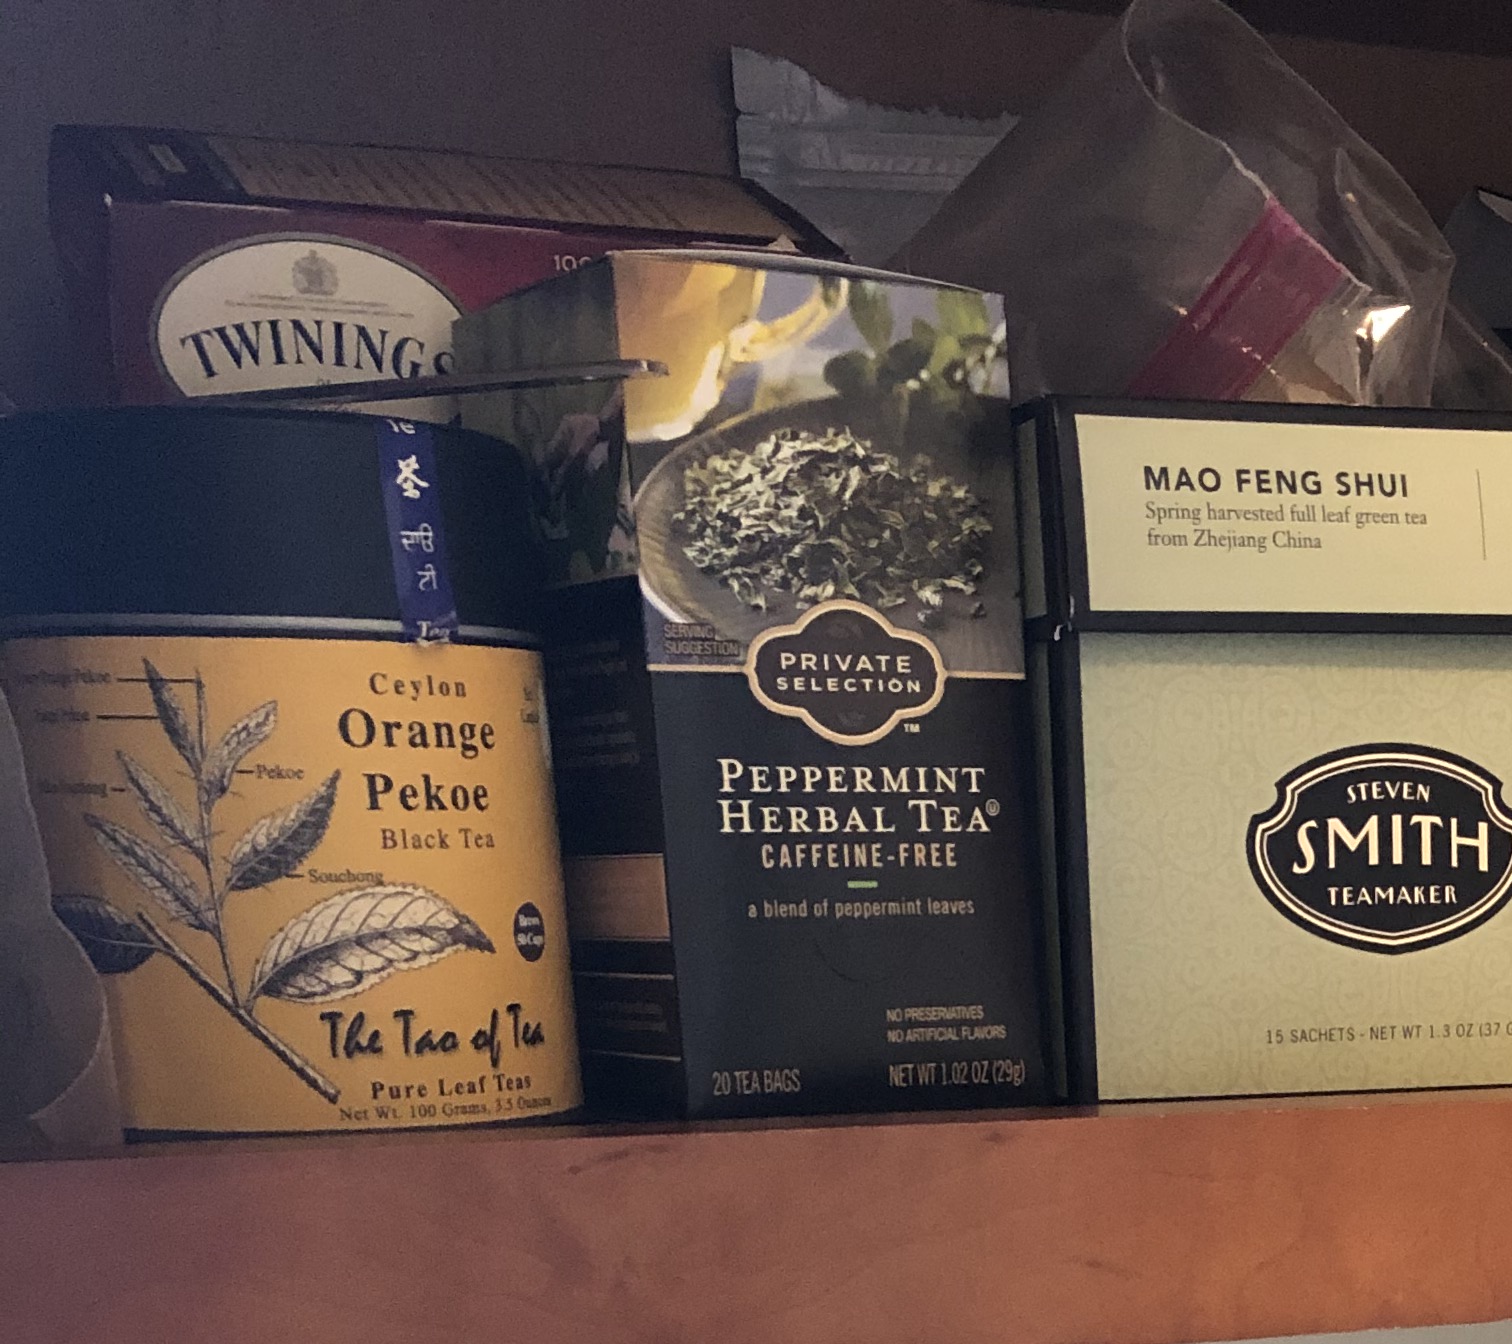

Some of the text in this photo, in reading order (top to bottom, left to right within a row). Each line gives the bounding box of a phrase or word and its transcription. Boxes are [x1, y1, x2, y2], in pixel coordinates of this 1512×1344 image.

[1143, 465, 1408, 499] MAO FENG SHUI
[1144, 501, 1428, 532] Spring harvested full leaf green tea
[1146, 527, 1322, 554] from Zhejiang China
[663, 623, 716, 640] SERVING
[663, 640, 740, 657] SUGGESTION
[780, 651, 913, 674] PRIVATE
[368, 673, 468, 701] Ceylon
[776, 675, 922, 695] SELECTION
[338, 708, 496, 760] Orange
[255, 764, 304, 780] Pekoe
[717, 757, 987, 794] PEPPERMINT
[361, 772, 490, 813] Pekoe
[1346, 781, 1431, 805] STEVEN
[717, 798, 991, 835] HERBAL TEA
[380, 828, 496, 851] Black Tea
[1292, 813, 1490, 875] SMITH
[761, 842, 959, 870] CAFFEINE-FREE
[308, 867, 384, 888] Souchong
[748, 896, 976, 921] a blend of peppermint leaves
[1327, 884, 1459, 907] TEAMAKER
[886, 1004, 985, 1024] NO PRESERVATIVES
[319, 1010, 384, 1059] The
[392, 1010, 459, 1058] Tao
[470, 1008, 501, 1068] of
[506, 1003, 545, 1048] Tea
[886, 1024, 1008, 1044] NO ARTIFICIAL FLAVORS
[1265, 1028, 1285, 1045] 15
[1290, 1026, 1356, 1045] SACHETS
[1369, 1026, 1398, 1042] NET
[1400, 1025, 1422, 1041] WT
[1428, 1023, 1451, 1040] 1.3
[1454, 1023, 1475, 1039] OZ
[1478, 1021, 1501, 1041] (37
[712, 1069, 801, 1097] 20 TEA BAGS
[888, 1057, 1026, 1088] NET WT 1.02 OZ (29g)
[370, 1073, 532, 1100] Pure Leaf Teas
[339, 1107, 369, 1122] Net
[410, 1104, 437, 1119] 100
[441, 1101, 492, 1117] Grams,
